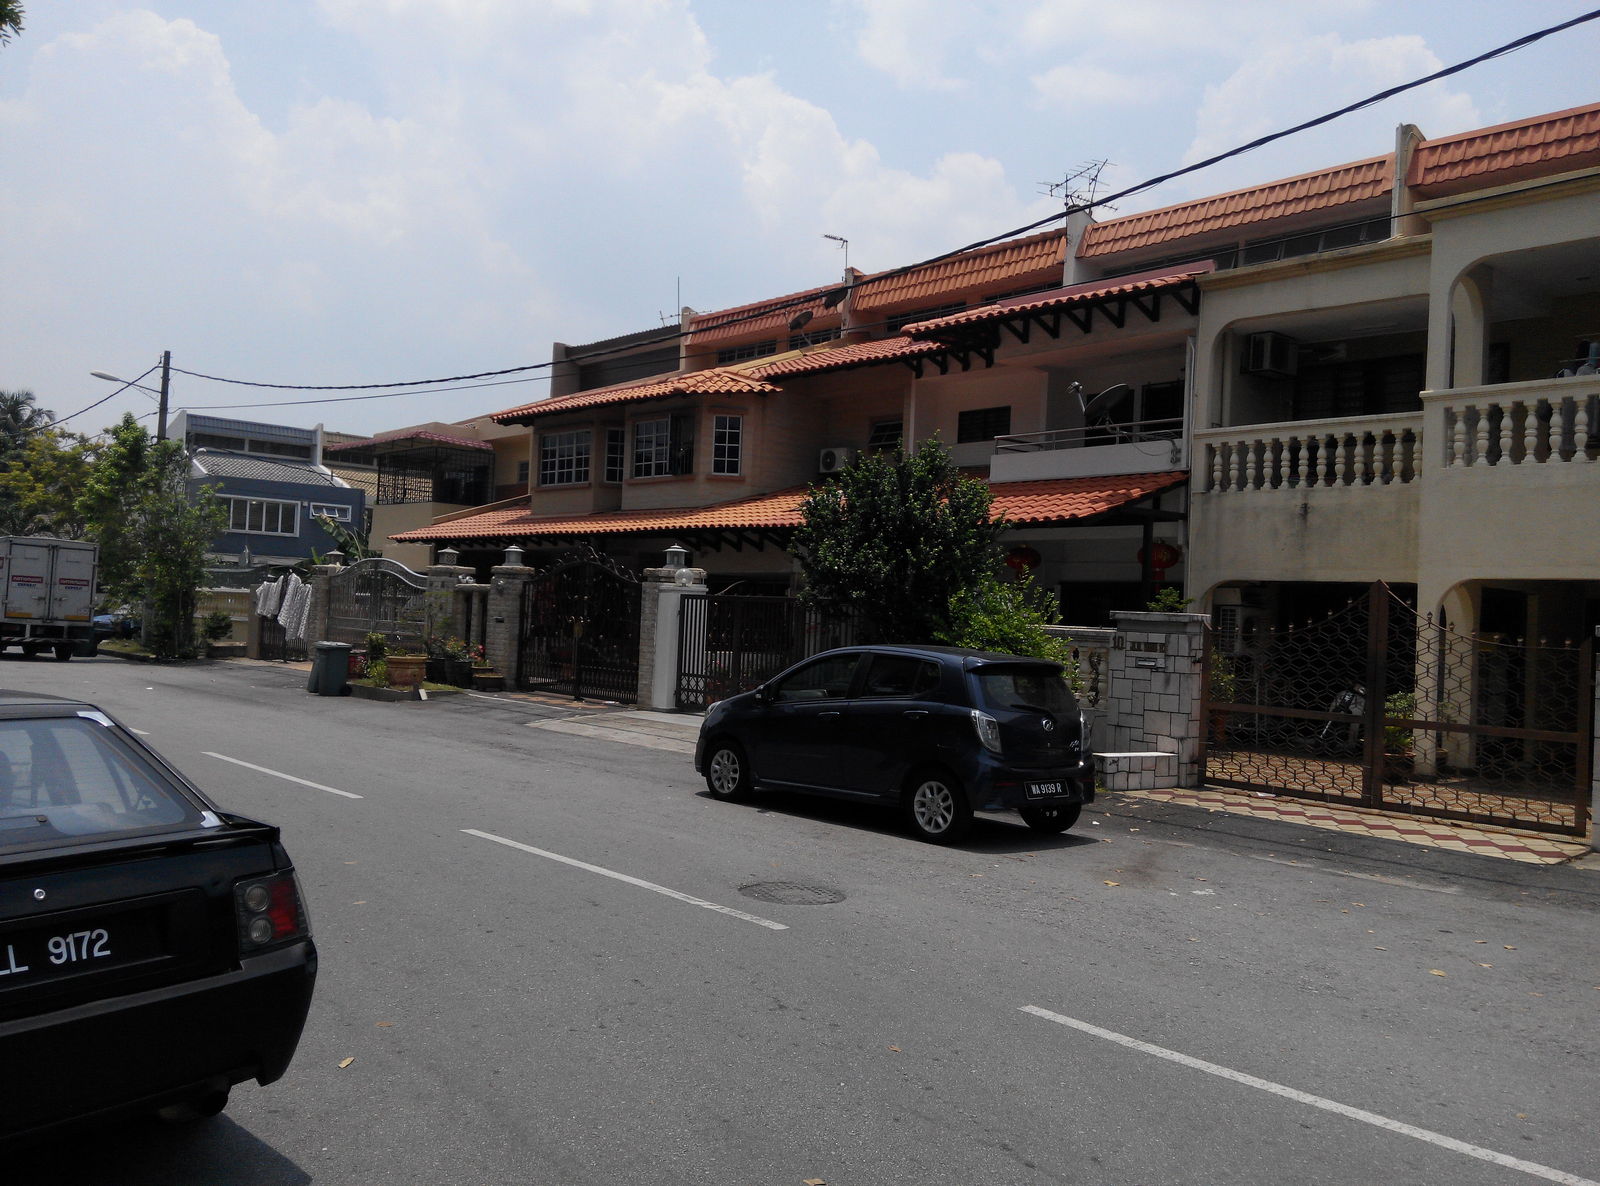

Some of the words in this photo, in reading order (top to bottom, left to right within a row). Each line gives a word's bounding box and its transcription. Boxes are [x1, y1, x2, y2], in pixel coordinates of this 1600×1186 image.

[1031, 784, 1041, 795] WA
[1040, 783, 1056, 794] 9139
[1056, 782, 1062, 793] R
[47, 928, 112, 965] 9172
